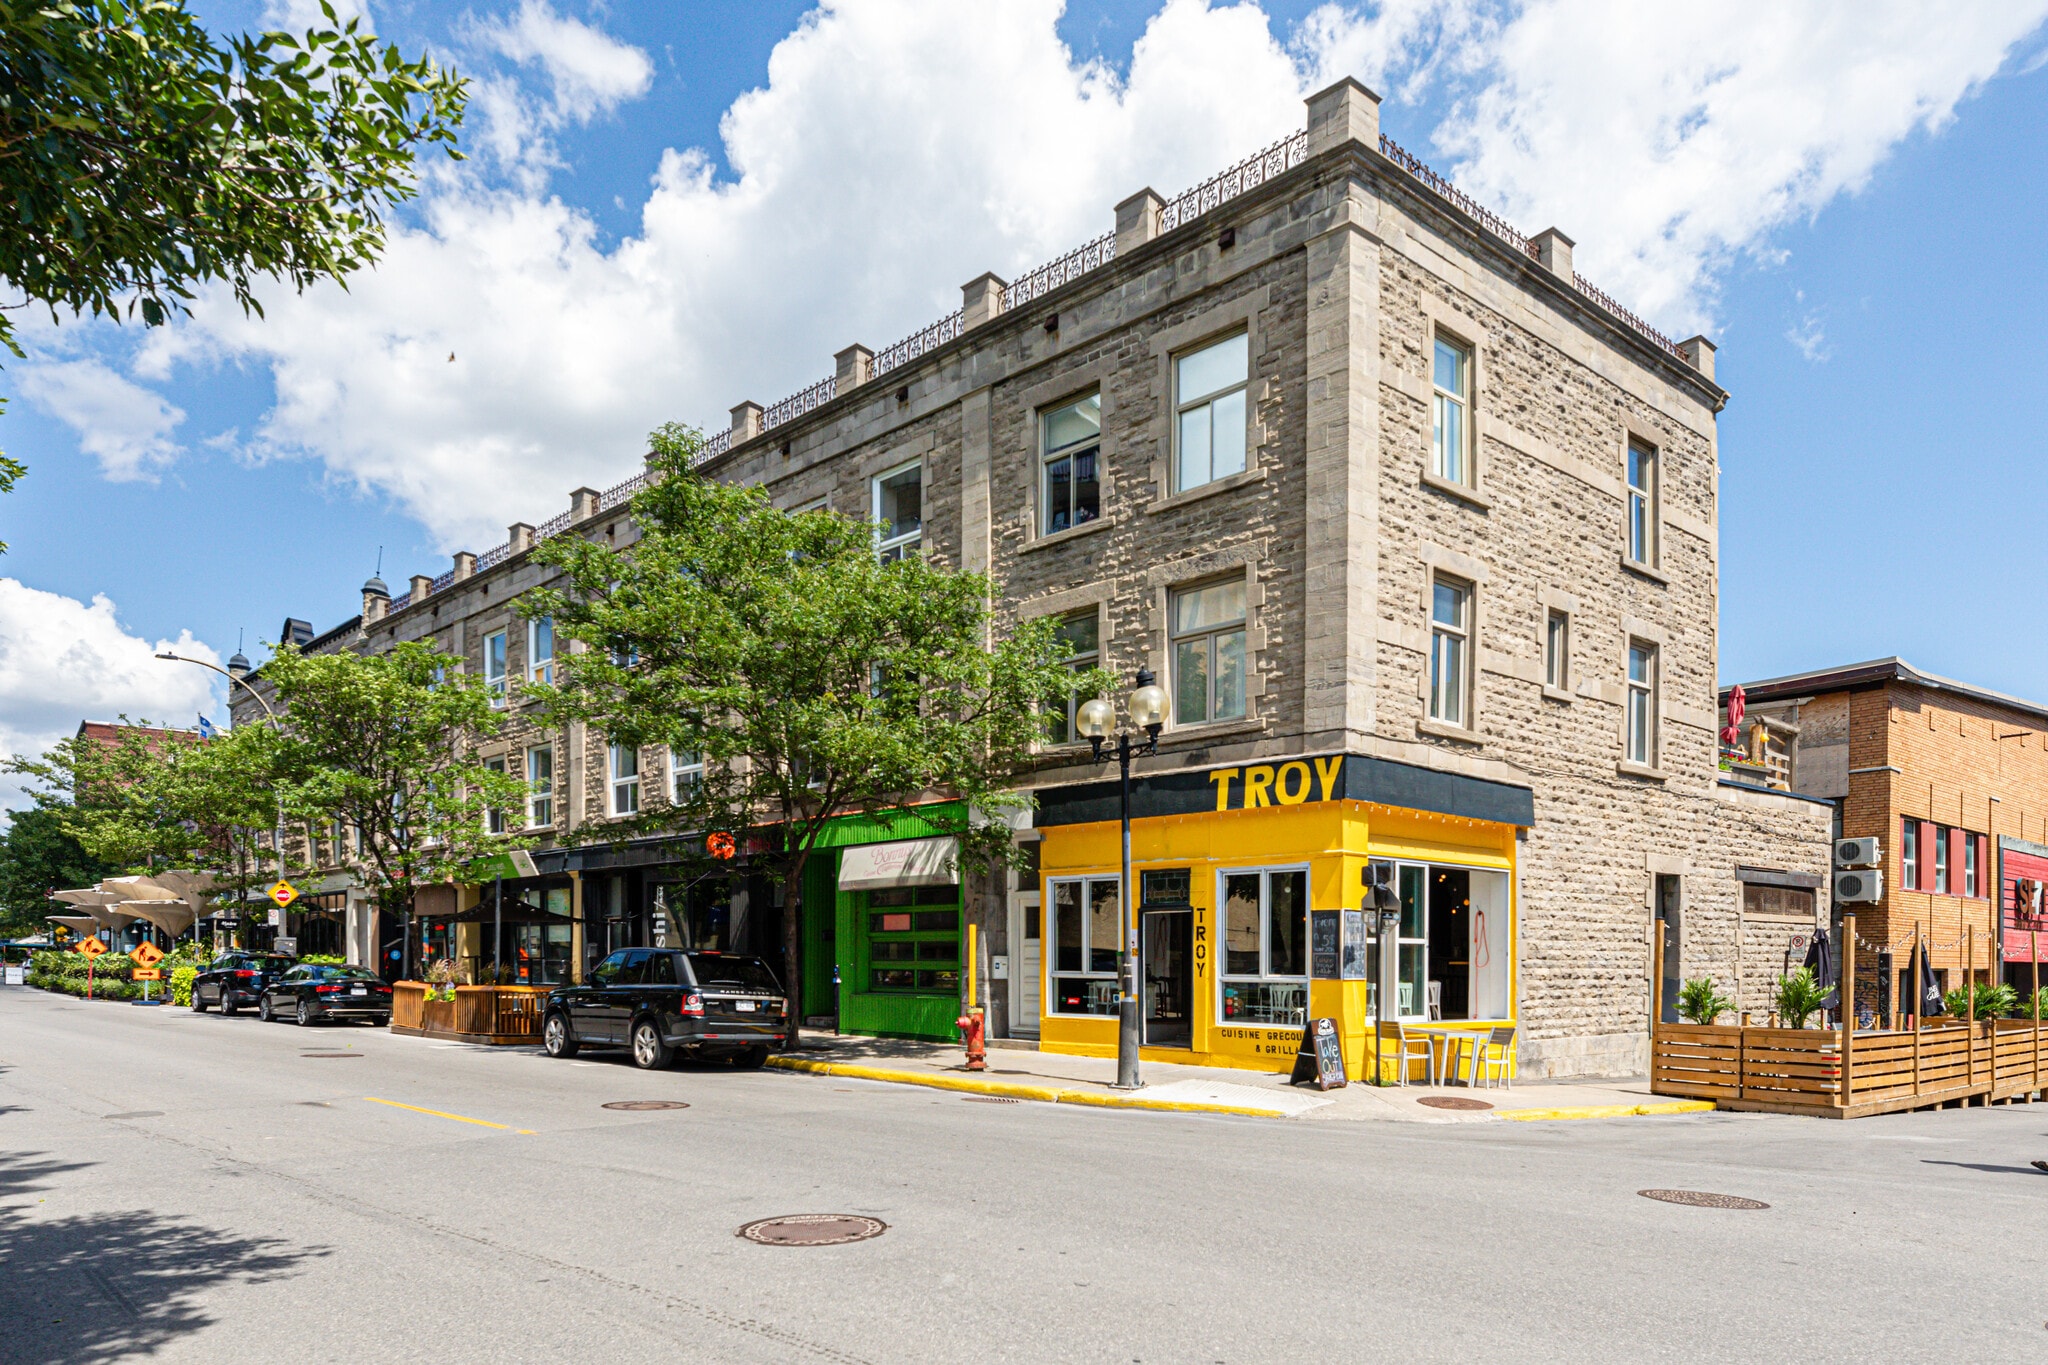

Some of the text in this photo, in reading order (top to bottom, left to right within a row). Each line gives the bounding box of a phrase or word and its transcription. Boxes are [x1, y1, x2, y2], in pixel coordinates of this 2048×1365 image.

[1209, 755, 1343, 811] TROY
[1196, 908, 1206, 977] TROY
[1221, 1029, 1260, 1040] CUISINE
[1315, 1034, 1339, 1058] Take
[1322, 1057, 1339, 1075] Out
